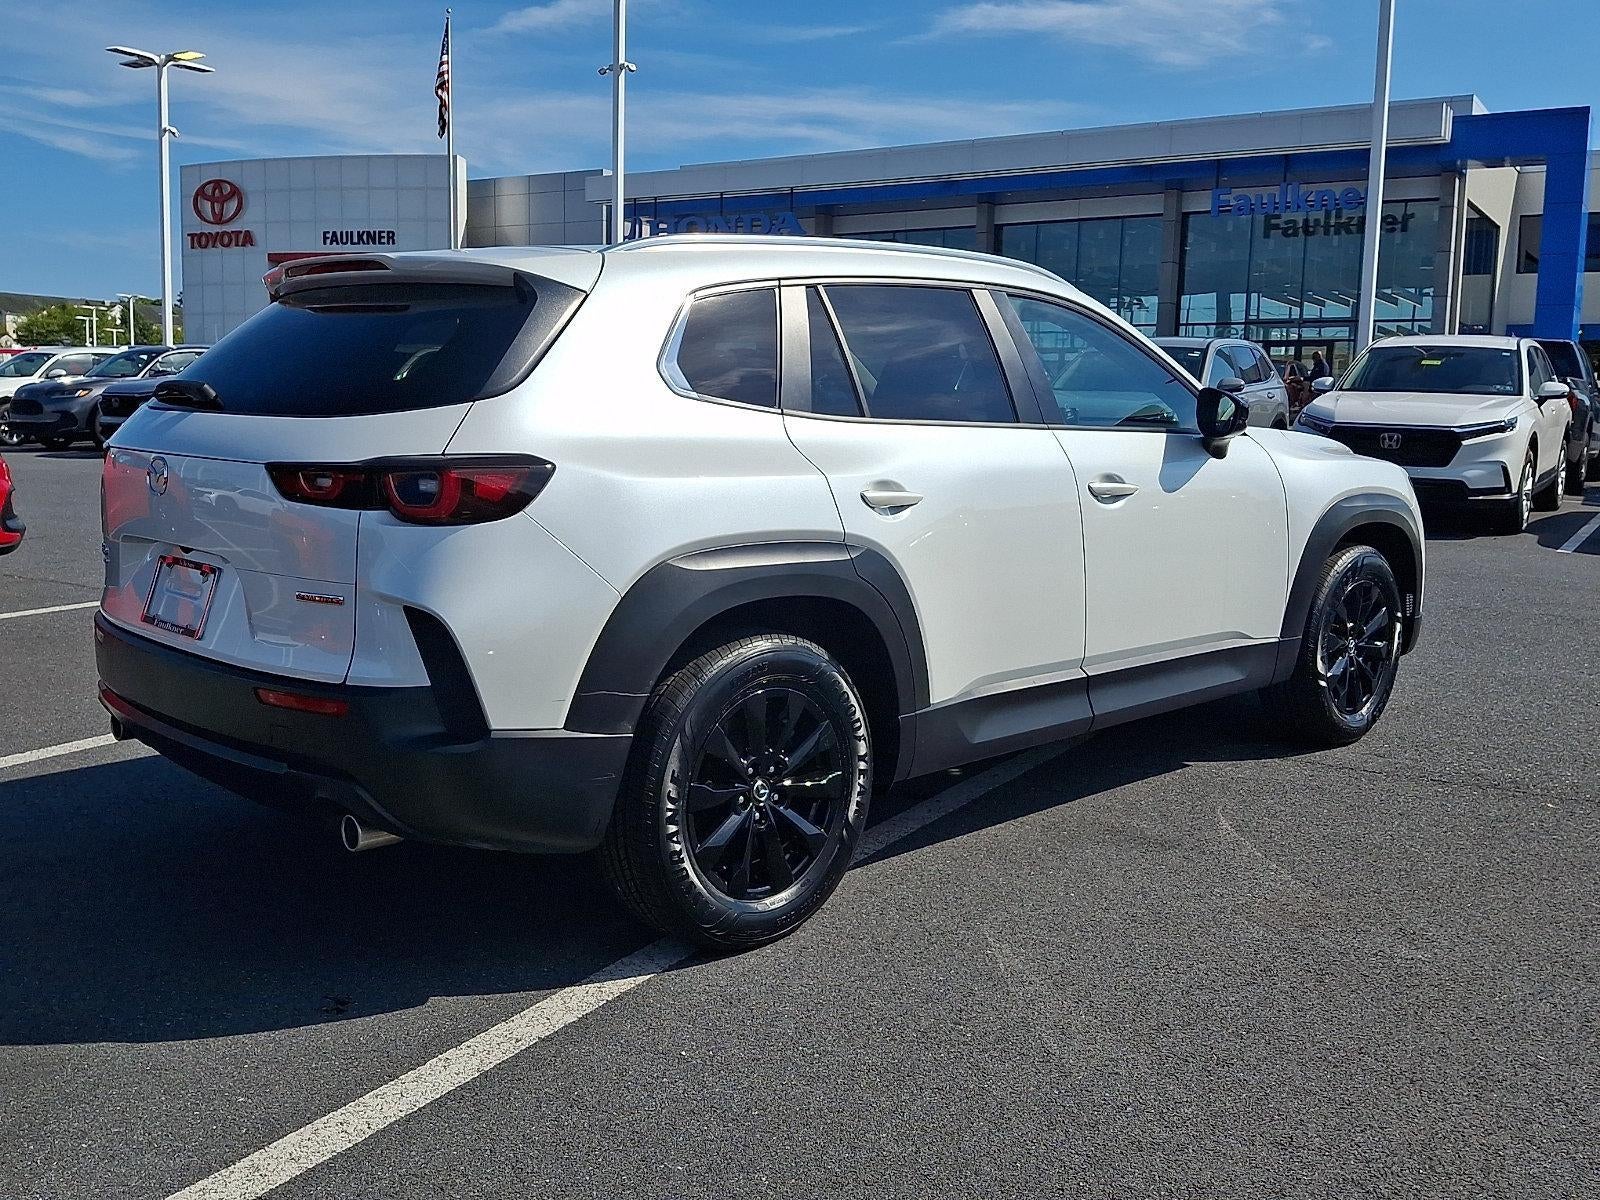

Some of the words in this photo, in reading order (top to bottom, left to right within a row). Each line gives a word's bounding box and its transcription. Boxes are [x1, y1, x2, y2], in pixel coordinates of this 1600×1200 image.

[1211, 182, 1369, 217] Faulkne
[651, 211, 807, 235] HONDA
[187, 230, 254, 249] TOYOTA
[322, 230, 396, 245] FAULKNER
